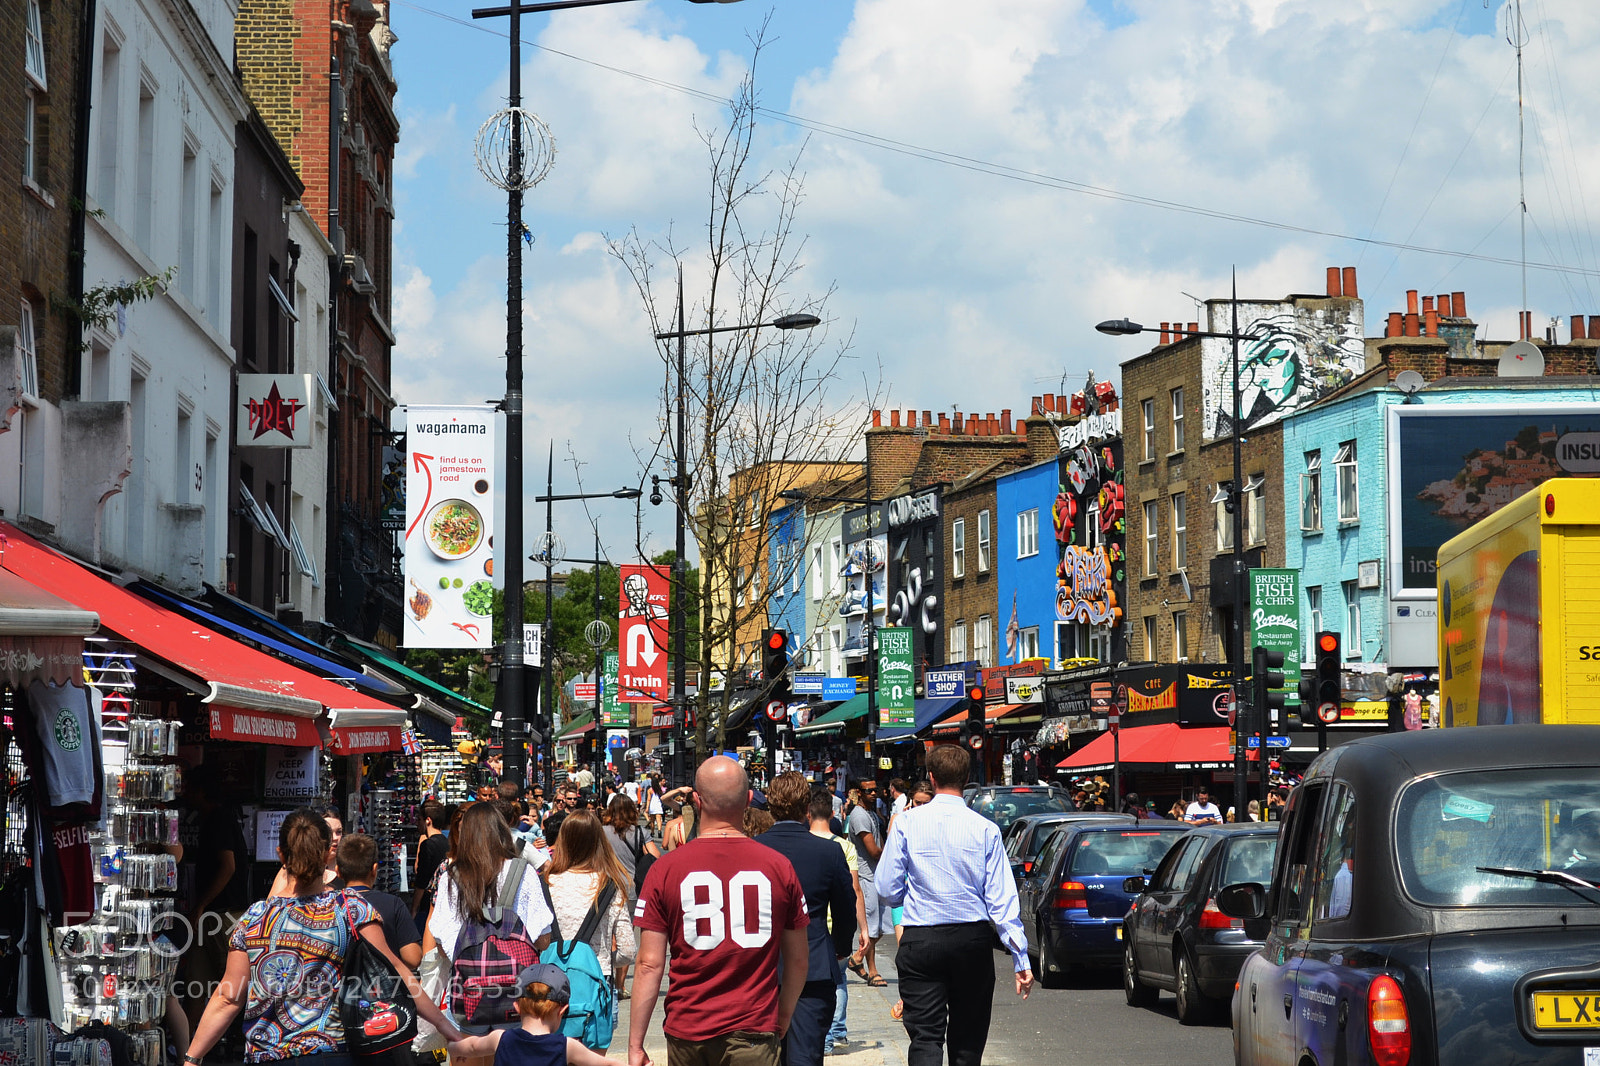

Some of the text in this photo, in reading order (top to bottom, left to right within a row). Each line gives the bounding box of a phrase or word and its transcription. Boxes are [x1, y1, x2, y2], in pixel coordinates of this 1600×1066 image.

[249, 398, 299, 430] PRET
[416, 423, 486, 436] wagamama
[440, 456, 456, 464] find
[439, 465, 486, 474] jamestown
[440, 474, 459, 482] road
[1255, 574, 1294, 584] BRITISH
[1255, 583, 1295, 598] FISH
[1255, 597, 1295, 606] & CHIPS
[1253, 607, 1298, 631] Poppies
[523, 630, 538, 641] CH
[1257, 632, 1293, 640] Restaurant
[882, 638, 909, 649] FISH
[880, 656, 912, 673] Poppies
[928, 672, 963, 683] LEATHER
[988, 668, 1008, 680] Leather
[1008, 664, 1034, 677] Garments
[623, 674, 662, 688] 1 min
[935, 682, 957, 692] SHOP
[1128, 681, 1176, 713] BENJAMIN
[279, 759, 303, 769] KEEP
[275, 770, 305, 780] CALM
[680, 870, 773, 950] 80
[1553, 997, 1600, 1023] LX5
